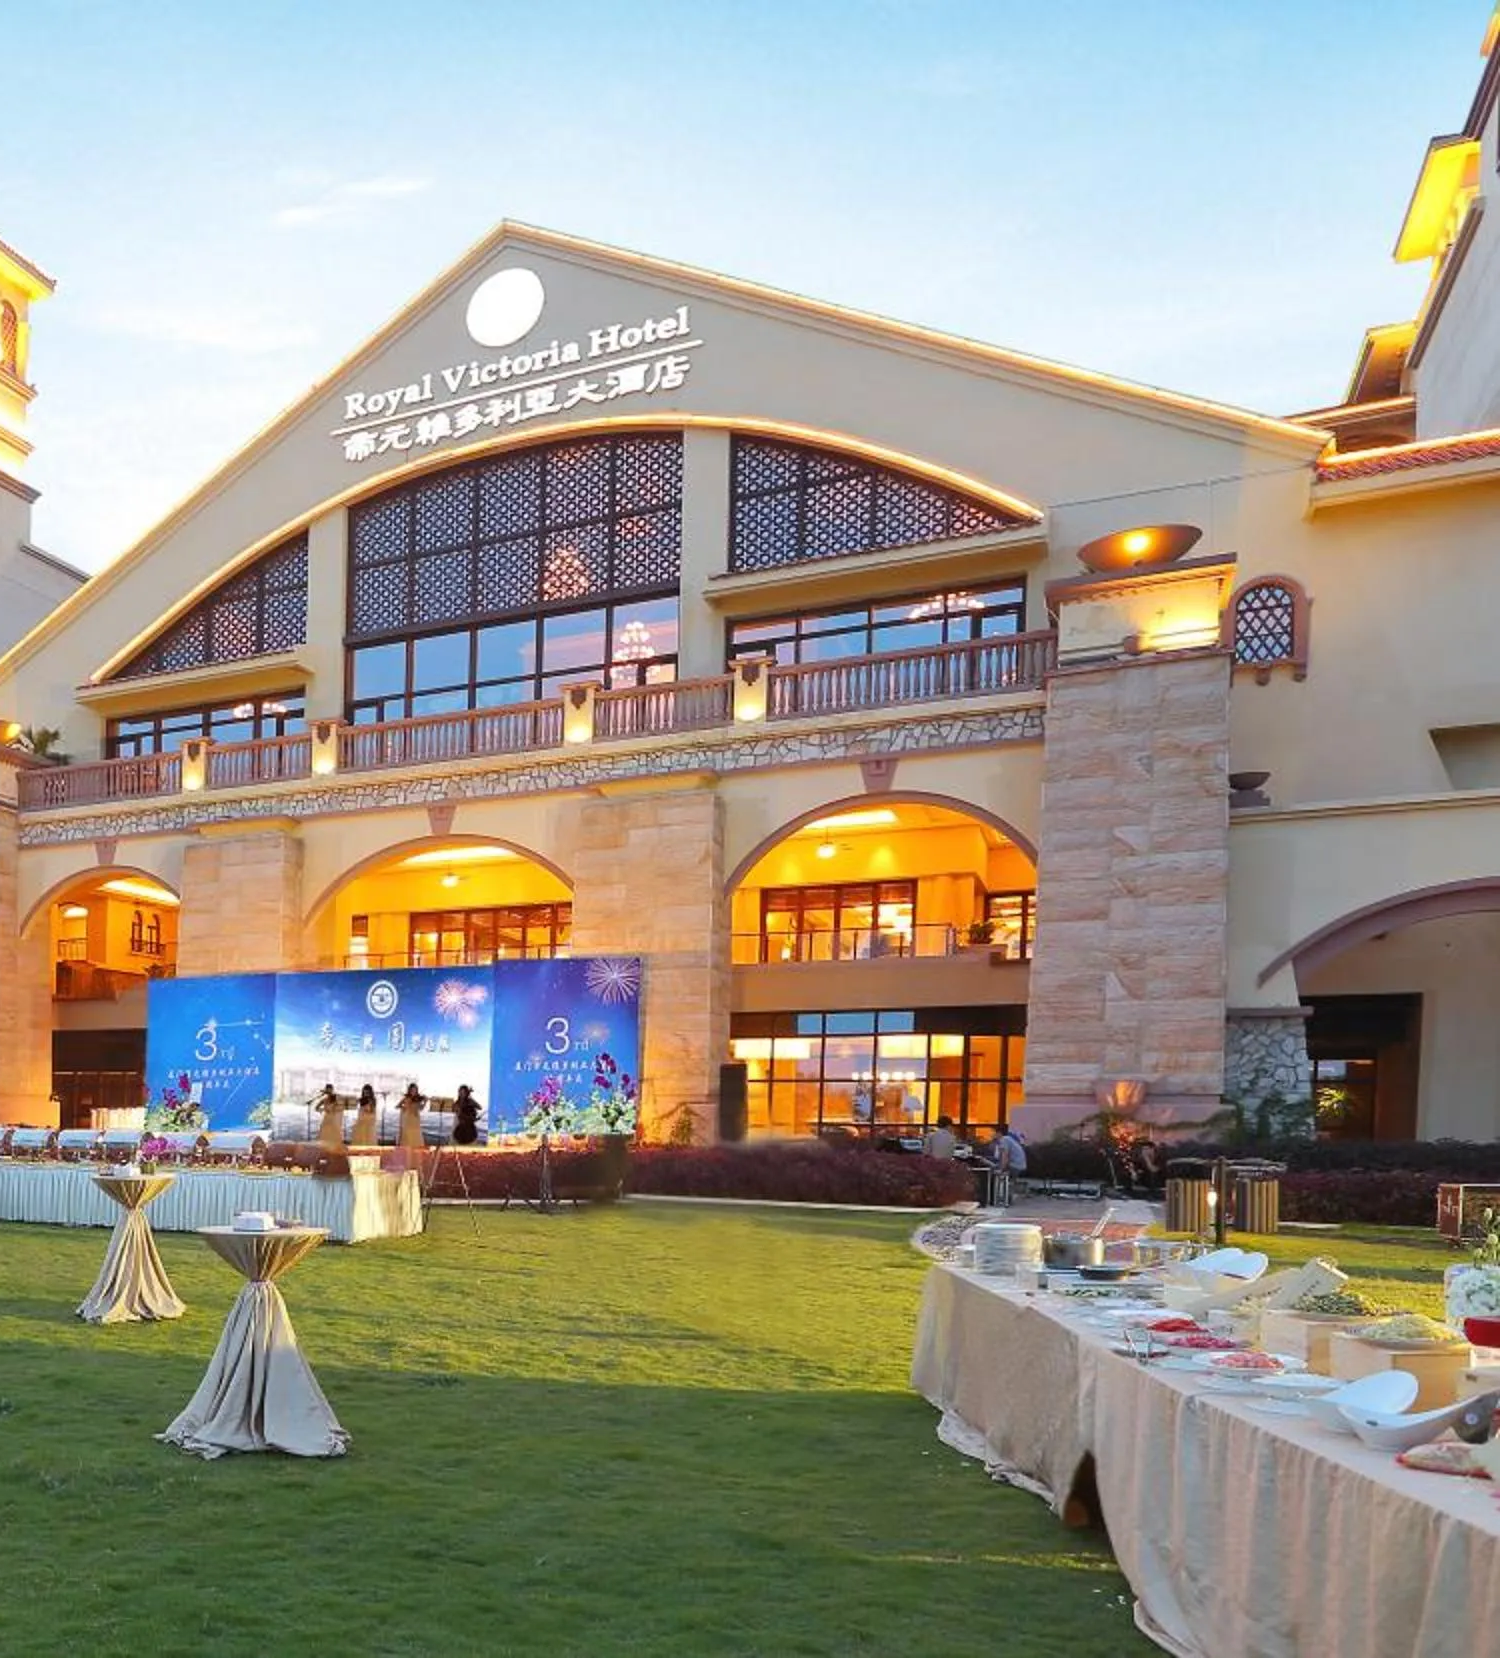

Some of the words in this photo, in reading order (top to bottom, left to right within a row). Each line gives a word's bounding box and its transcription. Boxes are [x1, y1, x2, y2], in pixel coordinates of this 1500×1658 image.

[344, 374, 433, 420] Royal
[441, 339, 580, 394] Victoria
[587, 307, 691, 357] Hotel
